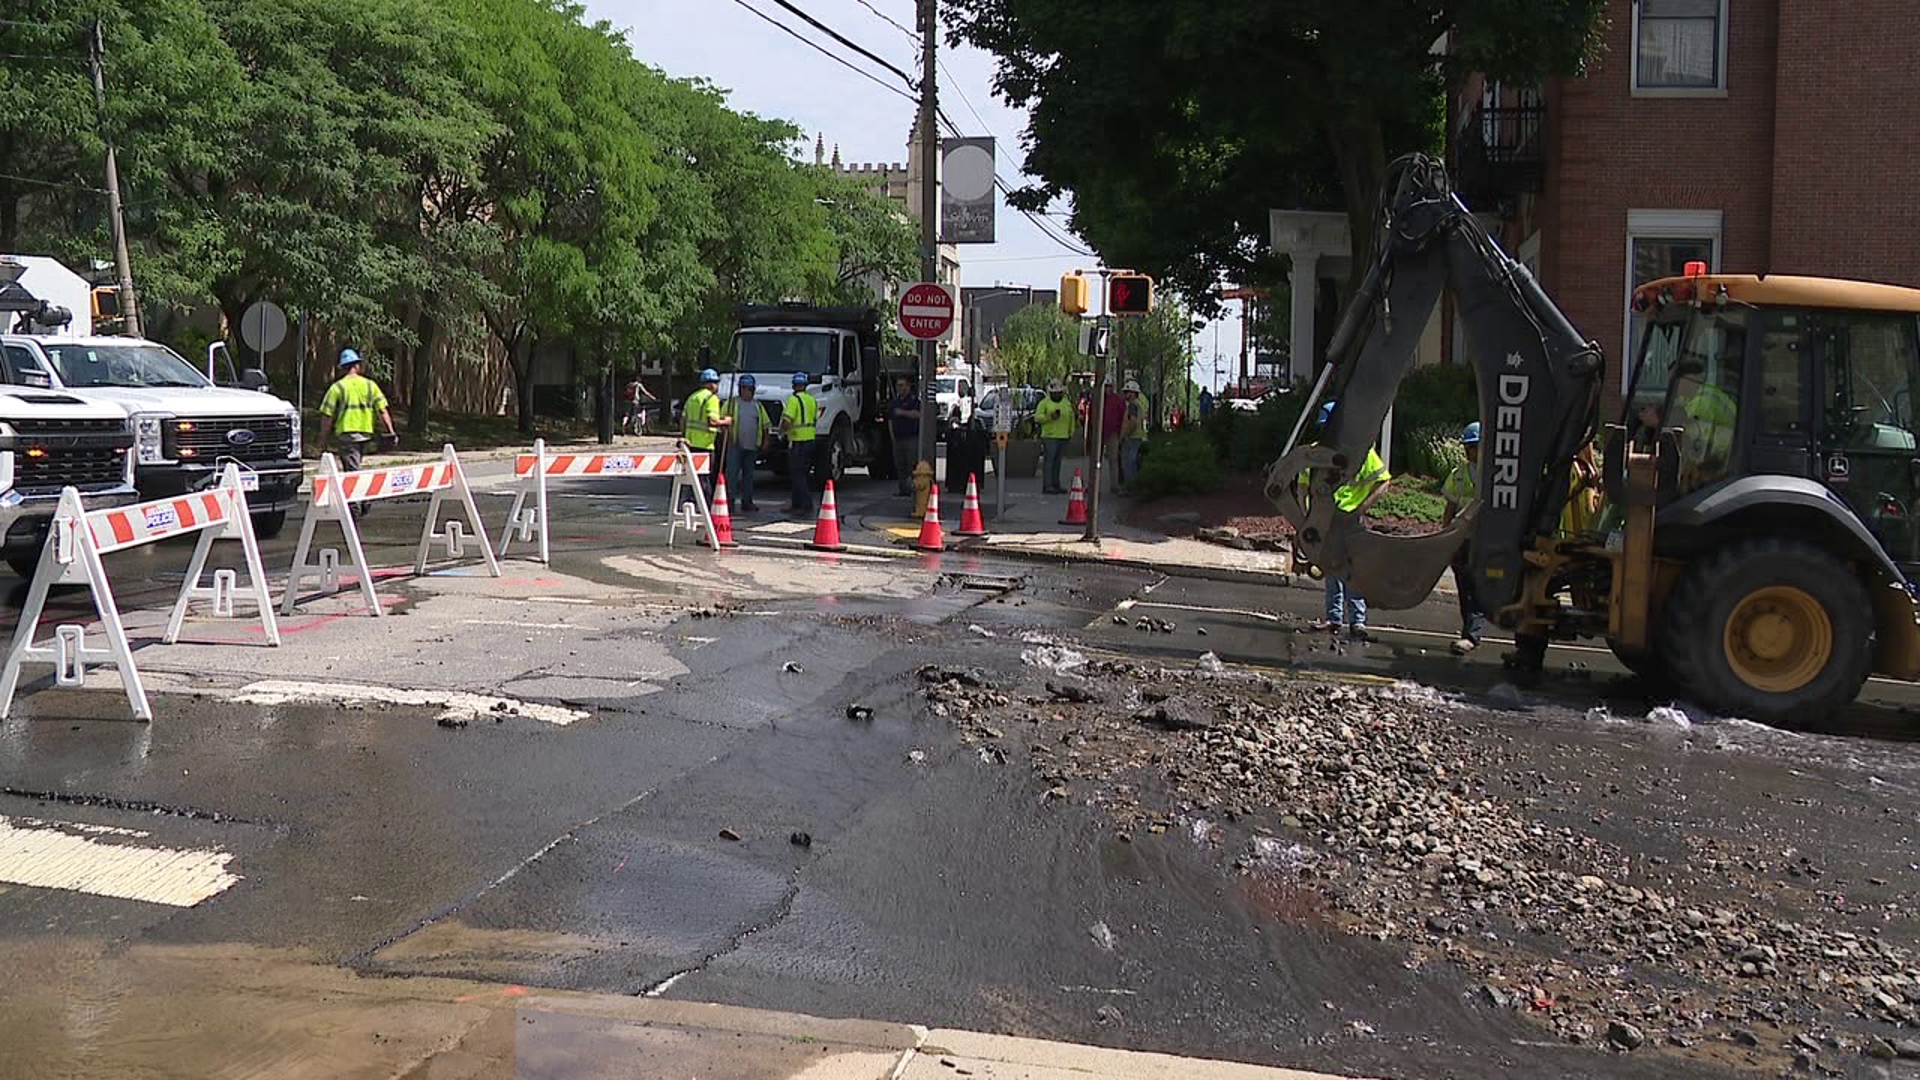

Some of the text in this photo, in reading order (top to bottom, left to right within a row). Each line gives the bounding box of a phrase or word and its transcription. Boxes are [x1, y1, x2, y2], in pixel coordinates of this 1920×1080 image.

[907, 294, 947, 305] DO NOT
[910, 318, 941, 329] ENTER
[1492, 374, 1530, 509] DEERE
[391, 473, 414, 487] POLICE
[146, 508, 175, 528] POLICE
